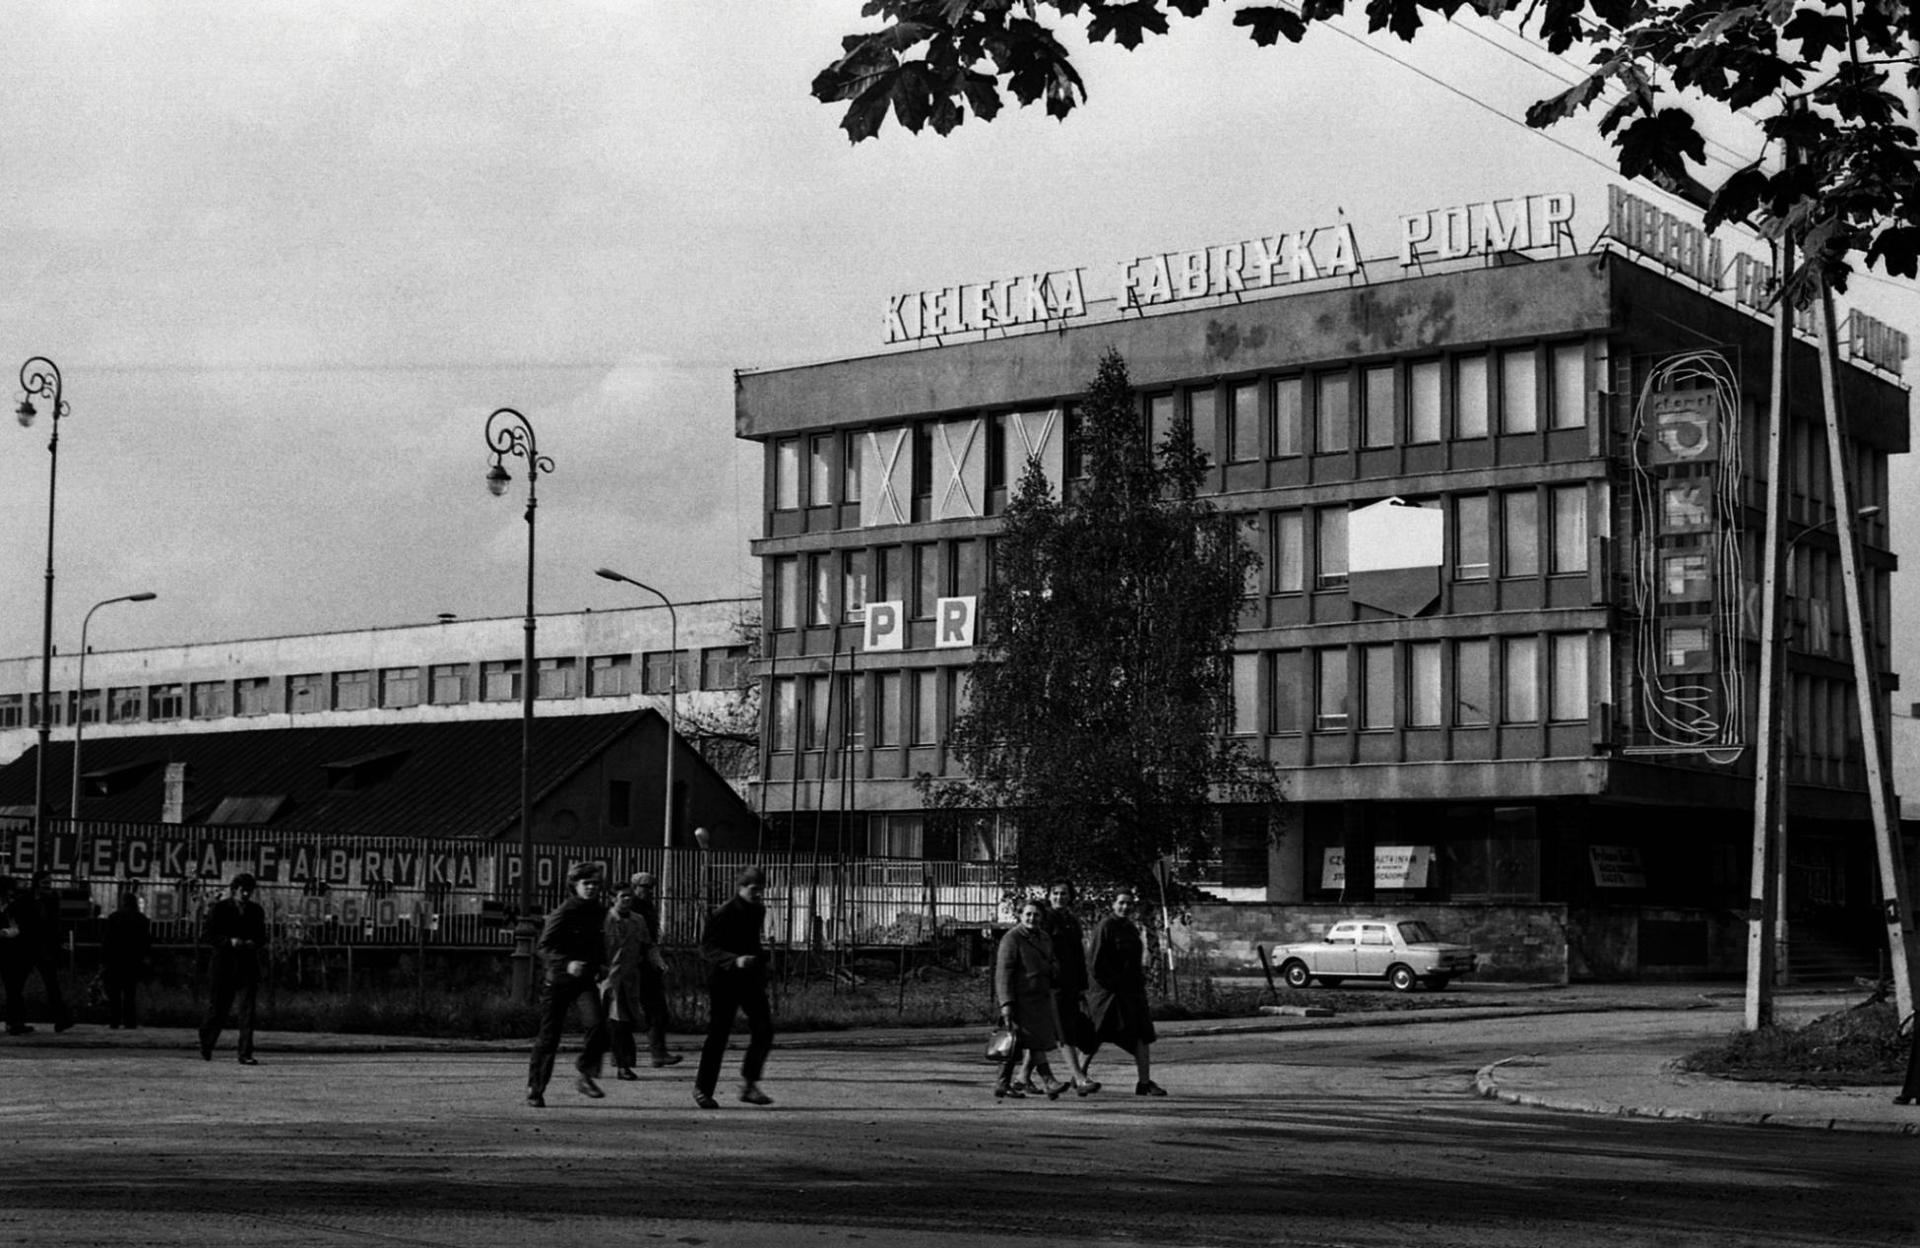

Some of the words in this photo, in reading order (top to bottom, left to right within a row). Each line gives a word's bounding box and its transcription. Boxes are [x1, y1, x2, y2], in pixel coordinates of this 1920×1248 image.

[883, 268, 1087, 344] KIELECKA
[1116, 223, 1360, 309] FABRYKA
[1398, 192, 1575, 268] POMP
[14, 834, 220, 877] ELECKA
[258, 845, 476, 885] FABRYKA
[507, 857, 608, 886] PO
